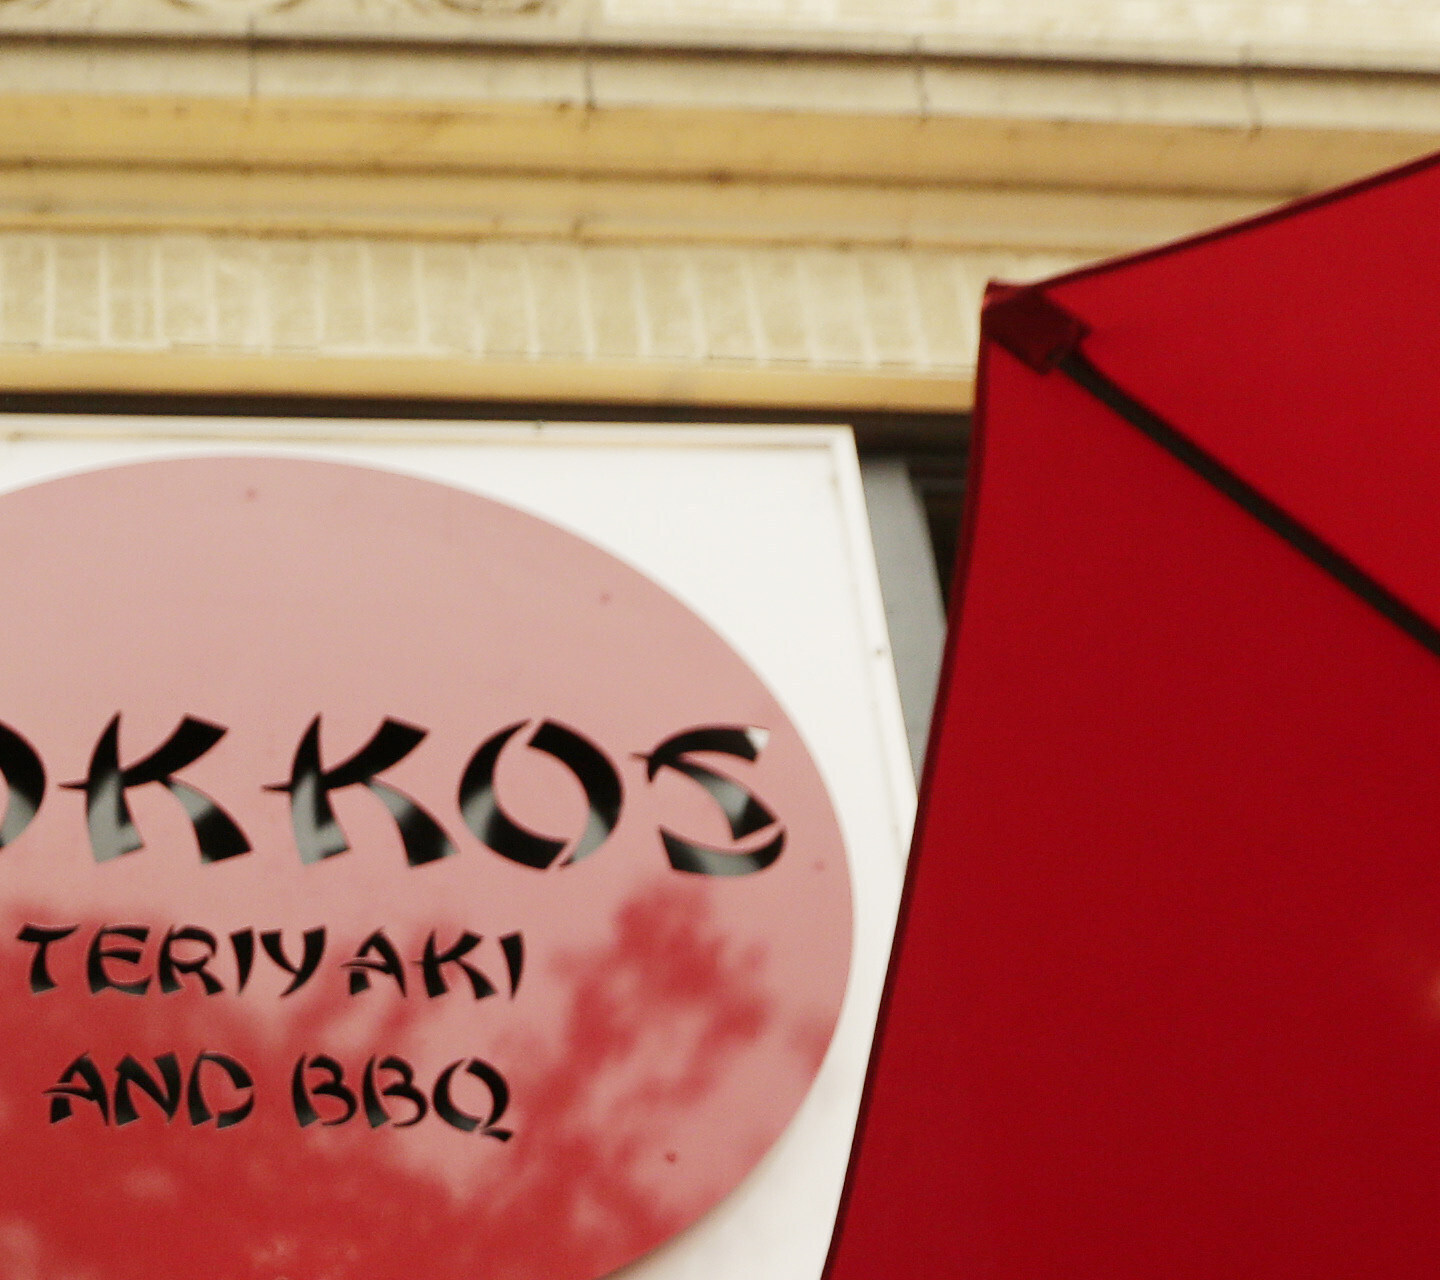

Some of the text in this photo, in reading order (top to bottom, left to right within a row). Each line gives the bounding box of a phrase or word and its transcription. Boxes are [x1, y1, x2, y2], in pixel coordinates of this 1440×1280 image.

[15, 922, 527, 1001] TERIYAKI
[42, 1050, 516, 1144] AND BBQ
